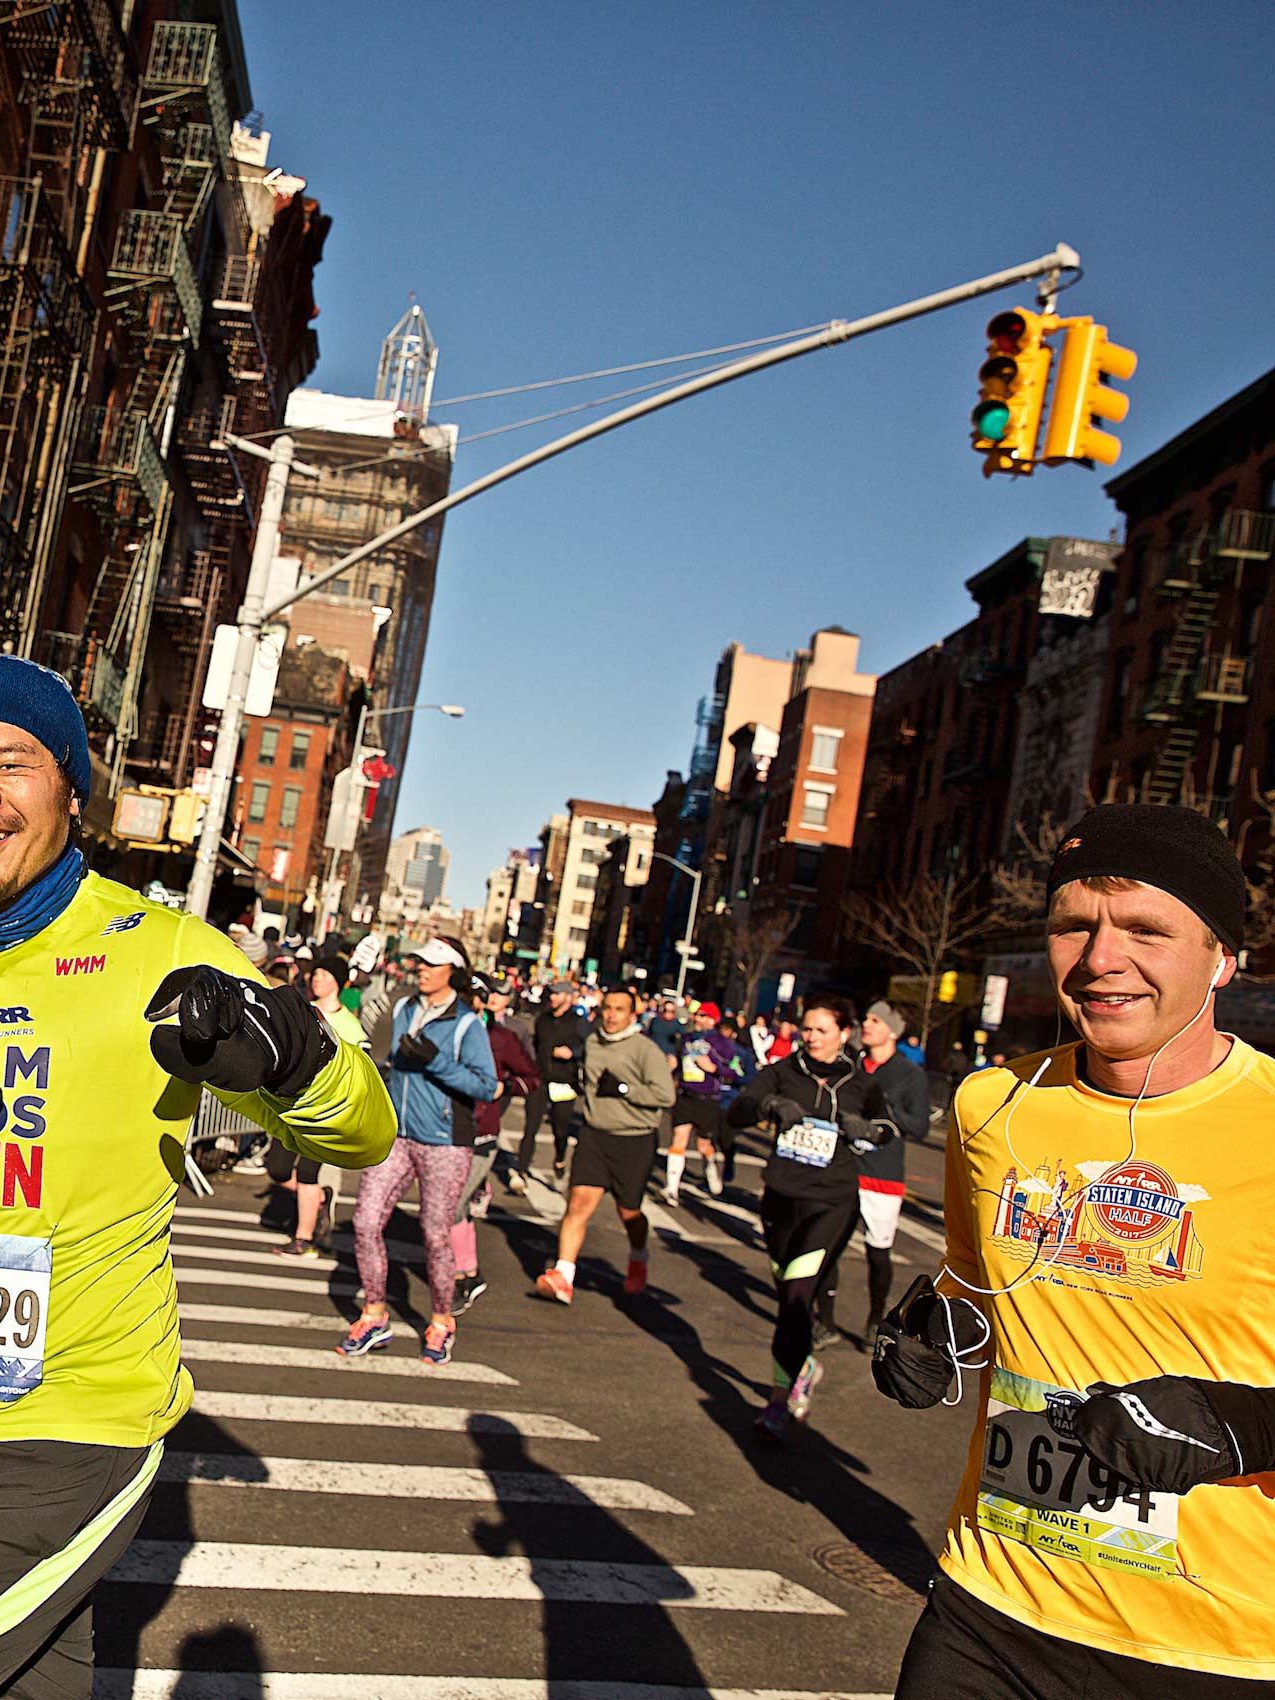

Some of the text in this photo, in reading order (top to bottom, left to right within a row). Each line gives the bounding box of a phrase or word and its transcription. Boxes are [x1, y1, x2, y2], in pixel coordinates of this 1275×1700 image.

[56, 954, 106, 976] WMM
[1091, 1186, 1181, 1217] STATEN ISLAND
[1108, 1207, 1153, 1227] HALF
[1114, 1228, 1140, 1239] 2017
[1052, 1404, 1077, 1422] NY
[988, 1424, 1157, 1524] D 6794
[1037, 1509, 1090, 1534] WAVE 1
[1097, 1552, 1162, 1573] #UnitedNYCHalf
